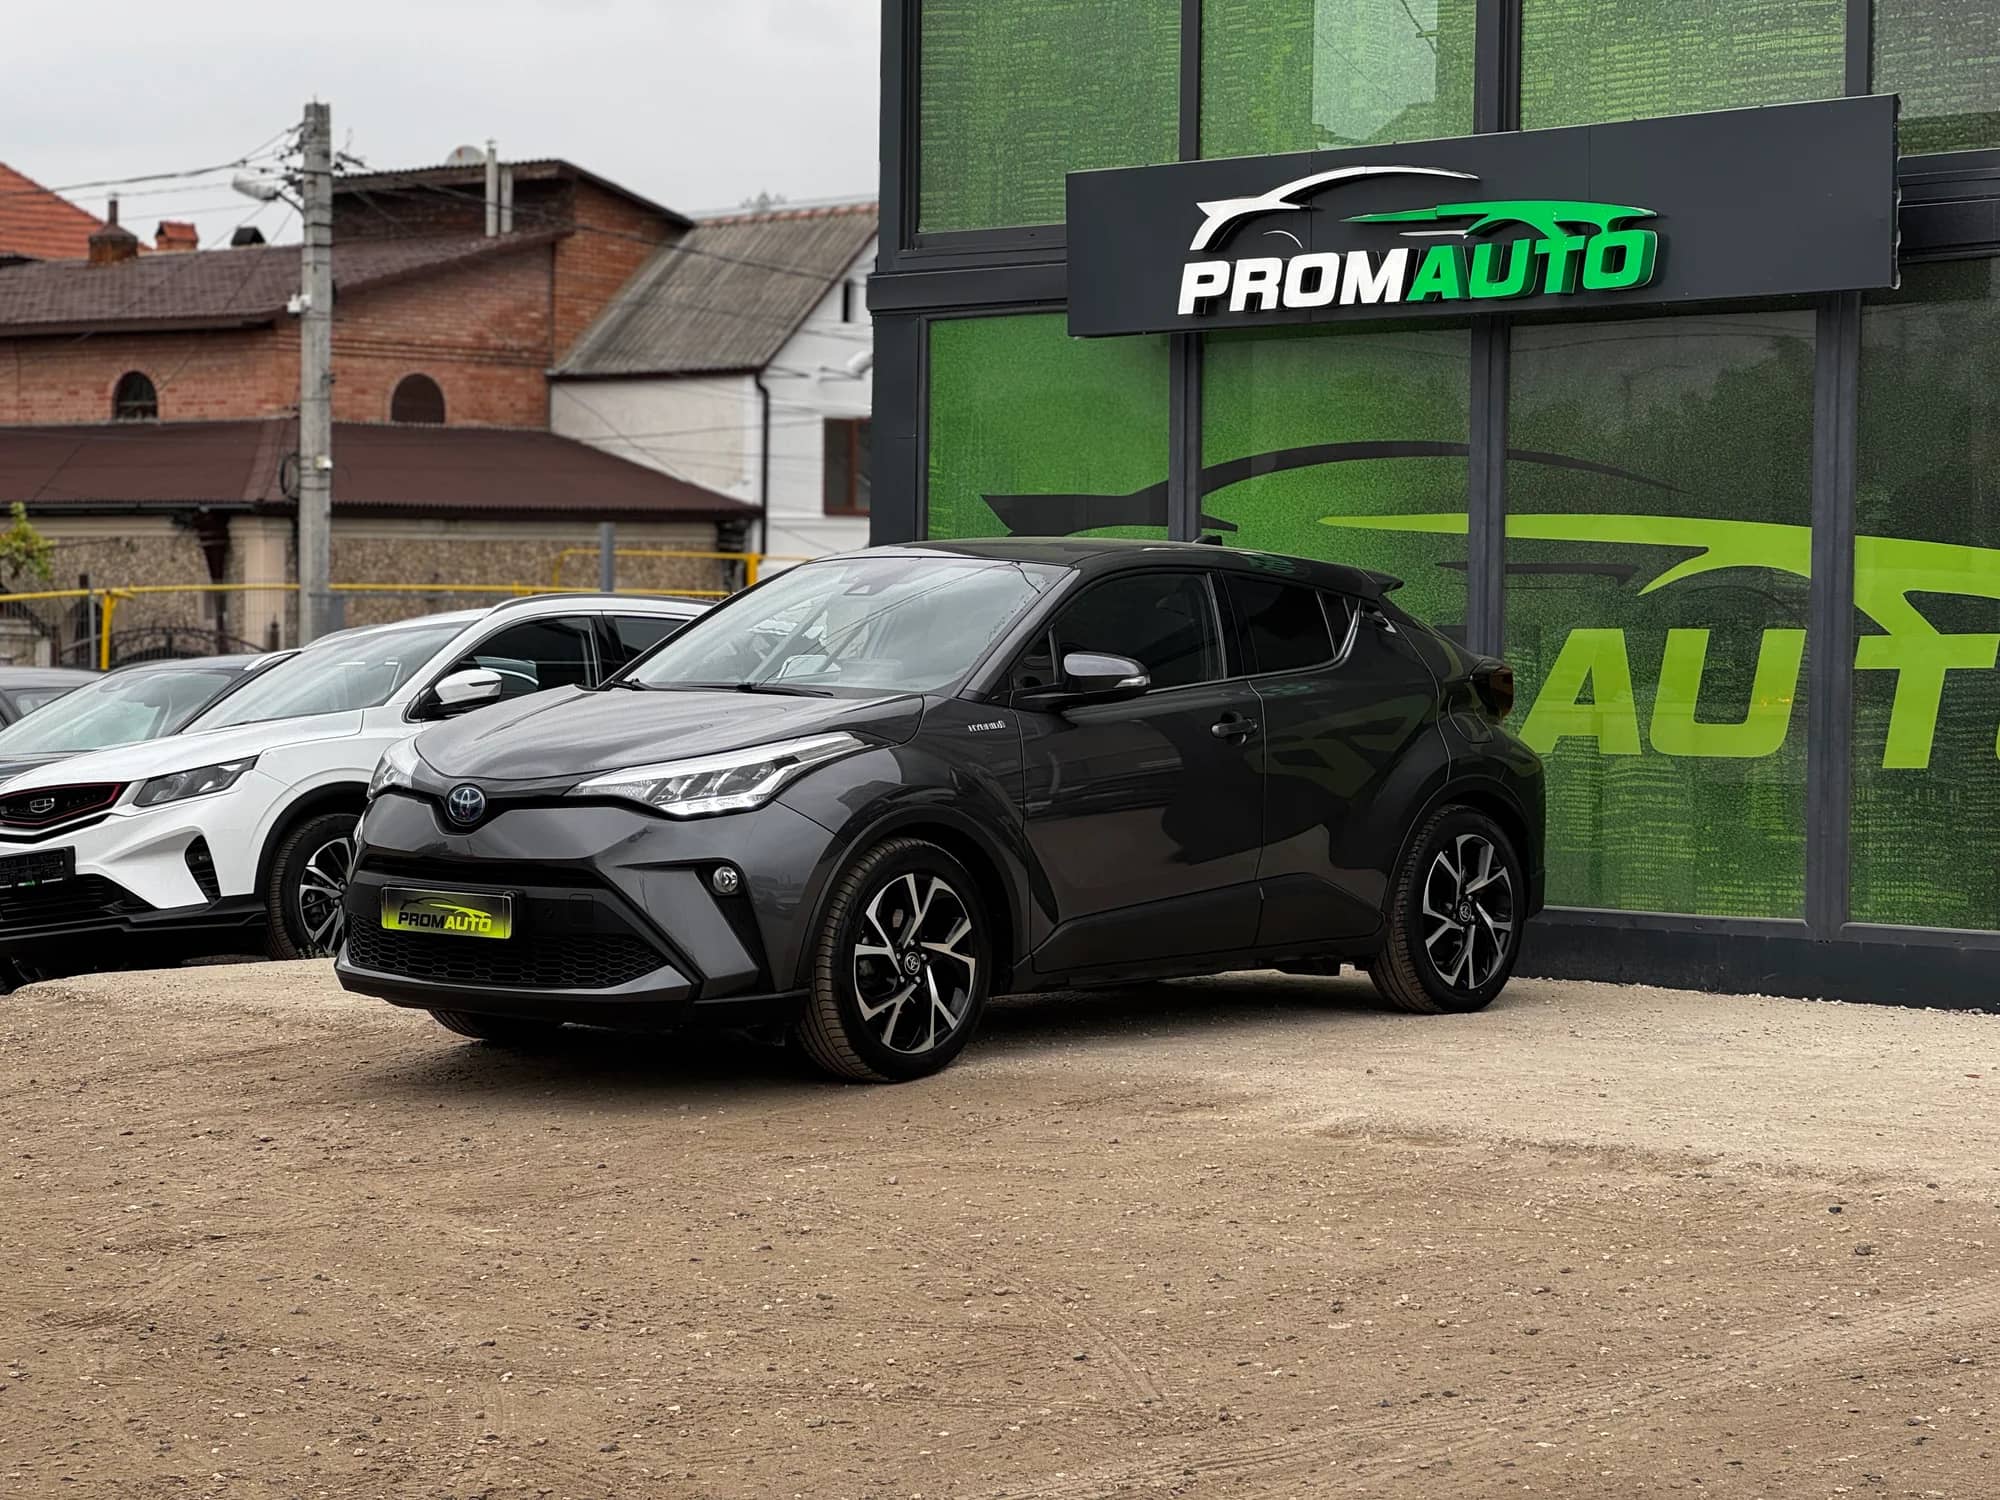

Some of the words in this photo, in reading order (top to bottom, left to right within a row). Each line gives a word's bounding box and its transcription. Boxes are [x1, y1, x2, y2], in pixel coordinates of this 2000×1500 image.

[1177, 229, 1657, 315] PROMAUTO
[1518, 628, 2000, 769] AUT
[398, 911, 492, 932] PROMAUTO
